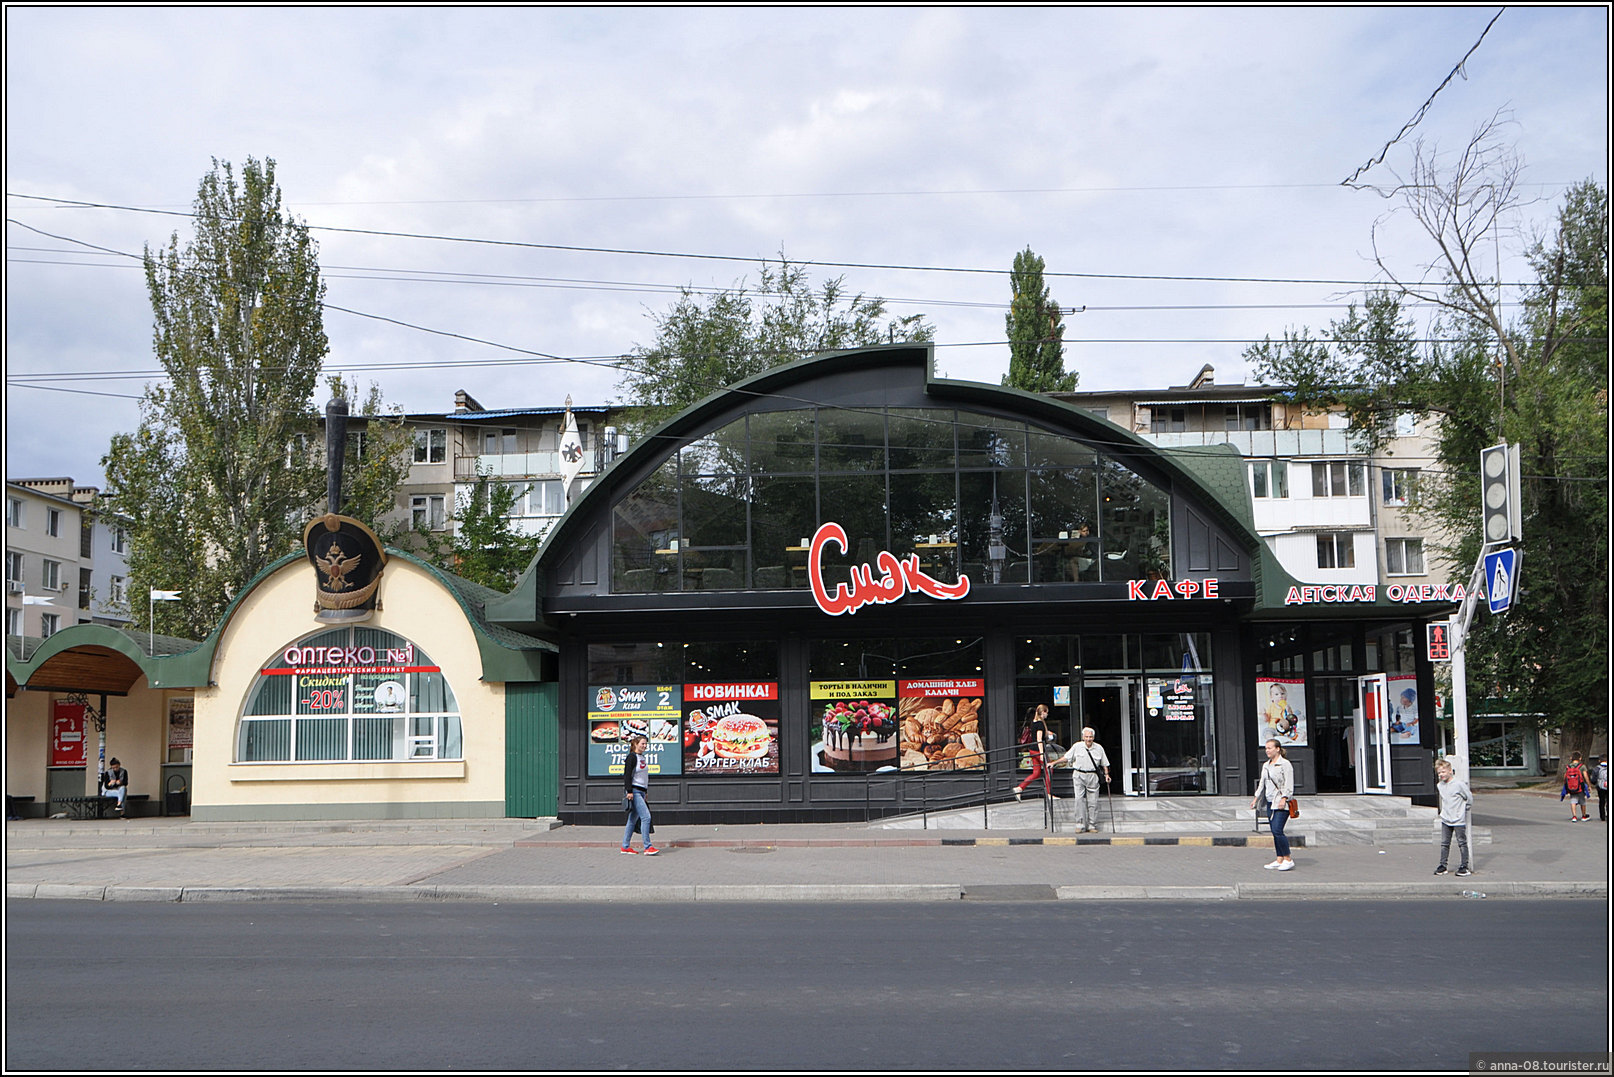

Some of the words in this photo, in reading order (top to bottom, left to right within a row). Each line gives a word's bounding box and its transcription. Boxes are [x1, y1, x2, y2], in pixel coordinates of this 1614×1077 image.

[1128, 579, 1219, 600] КАФЕ
[1285, 584, 1376, 605] ДЕТСКАЯ
[284, 646, 376, 665] аптека
[387, 644, 414, 663] №1
[1430, 642, 1449, 658] 26
[295, 667, 377, 675] ФАРМАЦЕВТИЧЕСКИЙ
[693, 685, 769, 698] НОВИНКА!
[906, 680, 954, 689] ДОМАШНИЙ
[301, 689, 344, 709] -20%
[658, 692, 670, 706] 2
[605, 744, 665, 754] ДОСВКА
[695, 758, 737, 768] БУРГЕР
[739, 757, 771, 768] КЛАБ
